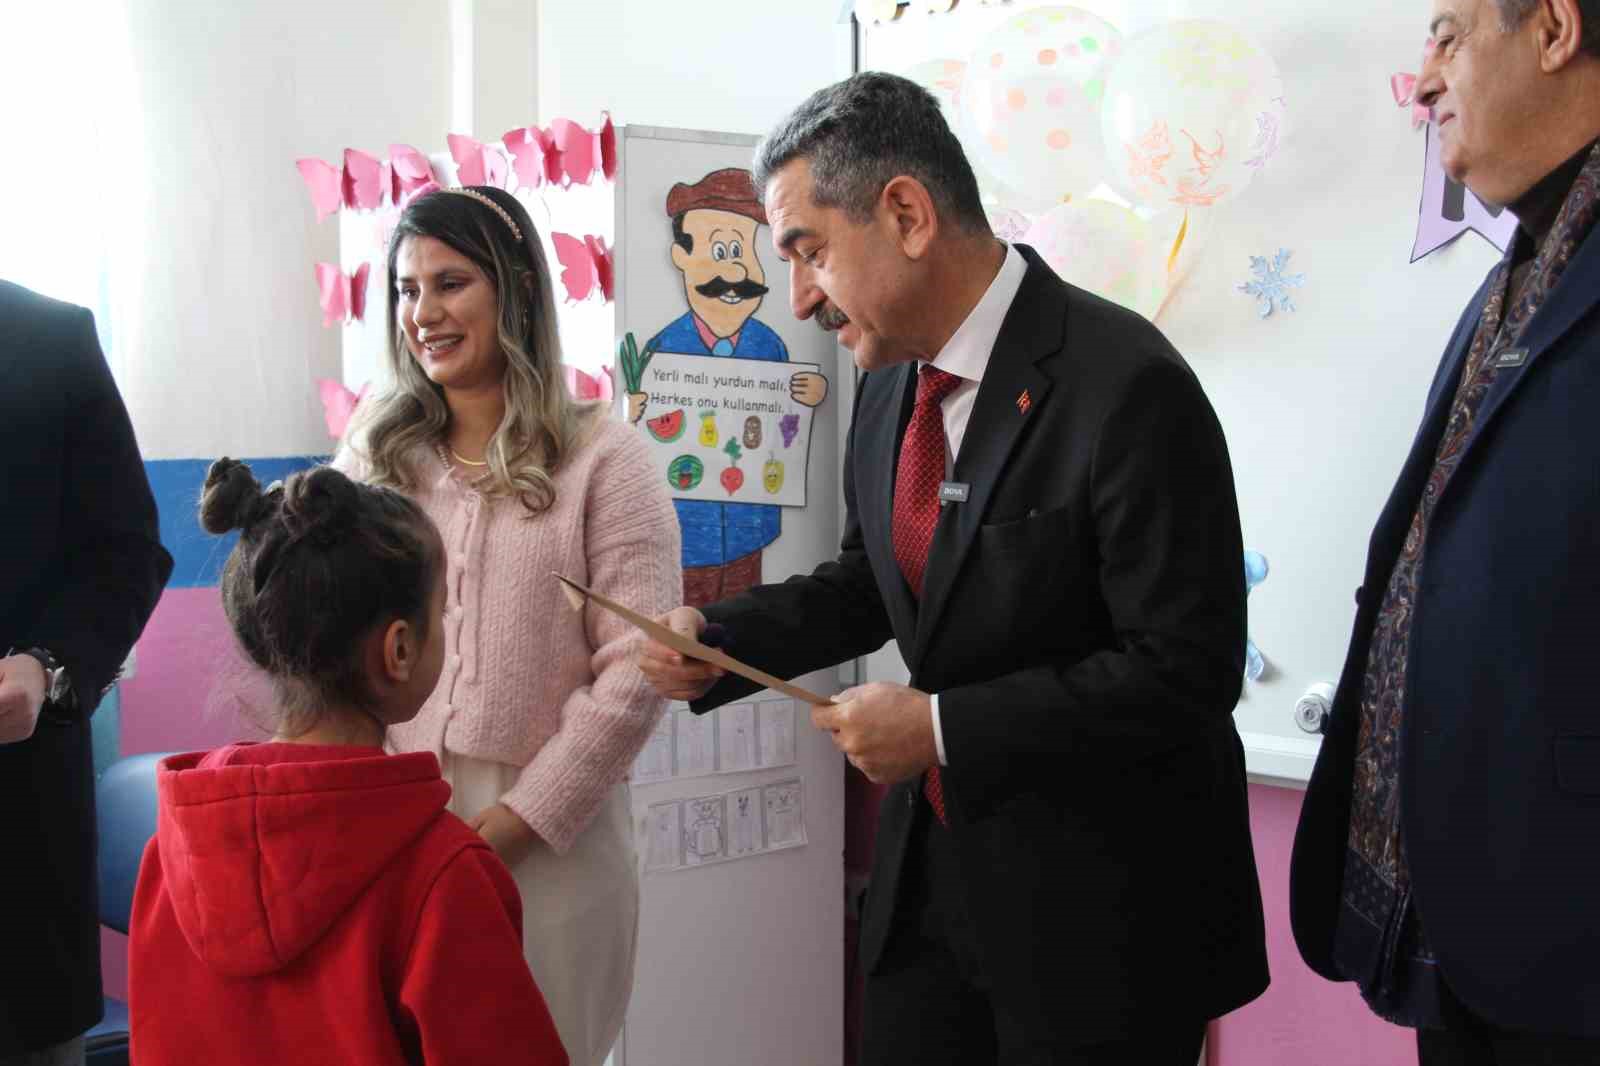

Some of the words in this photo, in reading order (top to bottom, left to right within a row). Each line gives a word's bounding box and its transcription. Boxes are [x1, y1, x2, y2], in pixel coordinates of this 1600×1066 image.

[653, 368, 680, 383] Yerli
[684, 372, 709, 385] malı
[713, 376, 754, 389] yurdun
[650, 392, 693, 407] Herkes
[697, 398, 718, 408] onu
